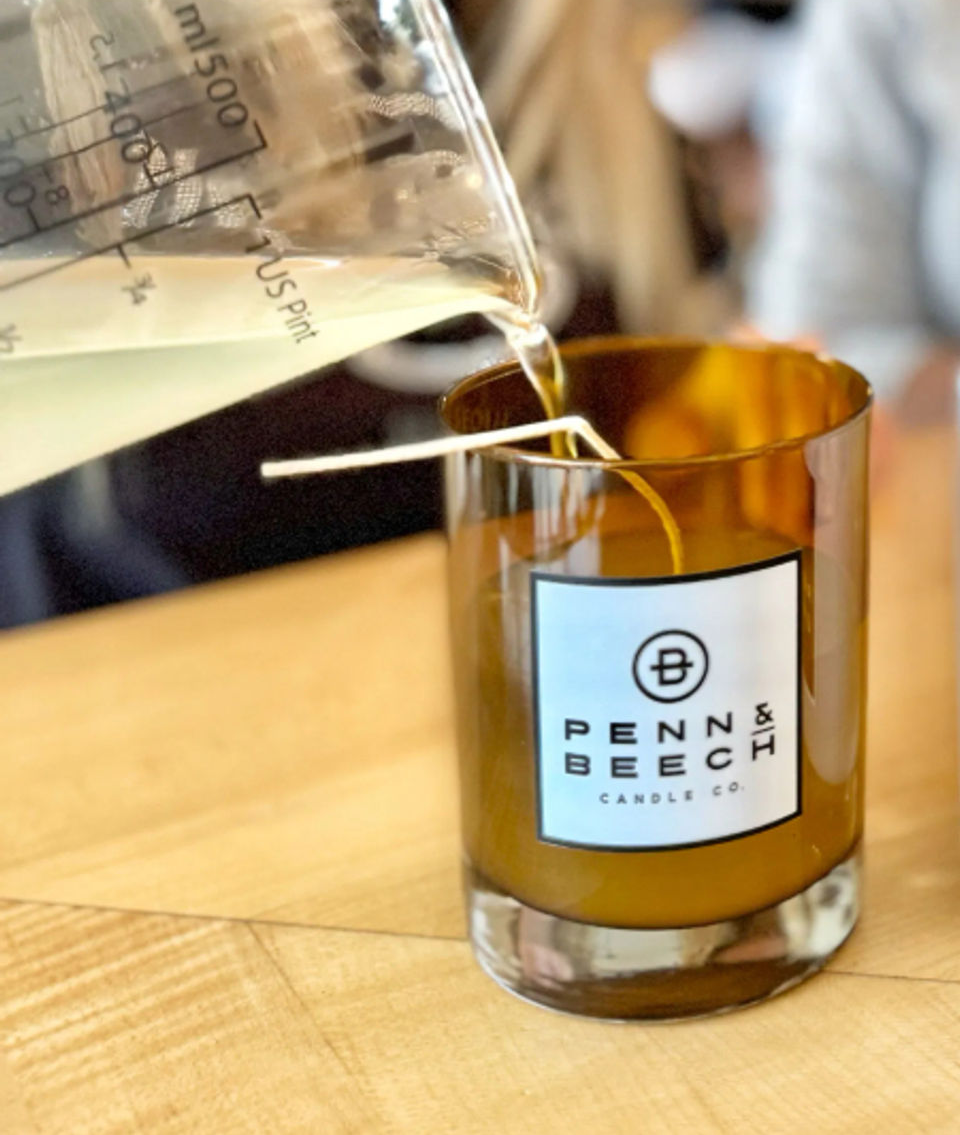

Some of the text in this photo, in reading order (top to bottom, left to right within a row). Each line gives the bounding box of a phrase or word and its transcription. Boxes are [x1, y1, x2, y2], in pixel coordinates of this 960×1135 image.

[103, 77, 152, 165] 400
[245, 235, 320, 345] 1 US Pint
[564, 702, 774, 745] PENN &
[564, 734, 775, 779] BEECH
[599, 781, 746, 804] CANDLE CO.
